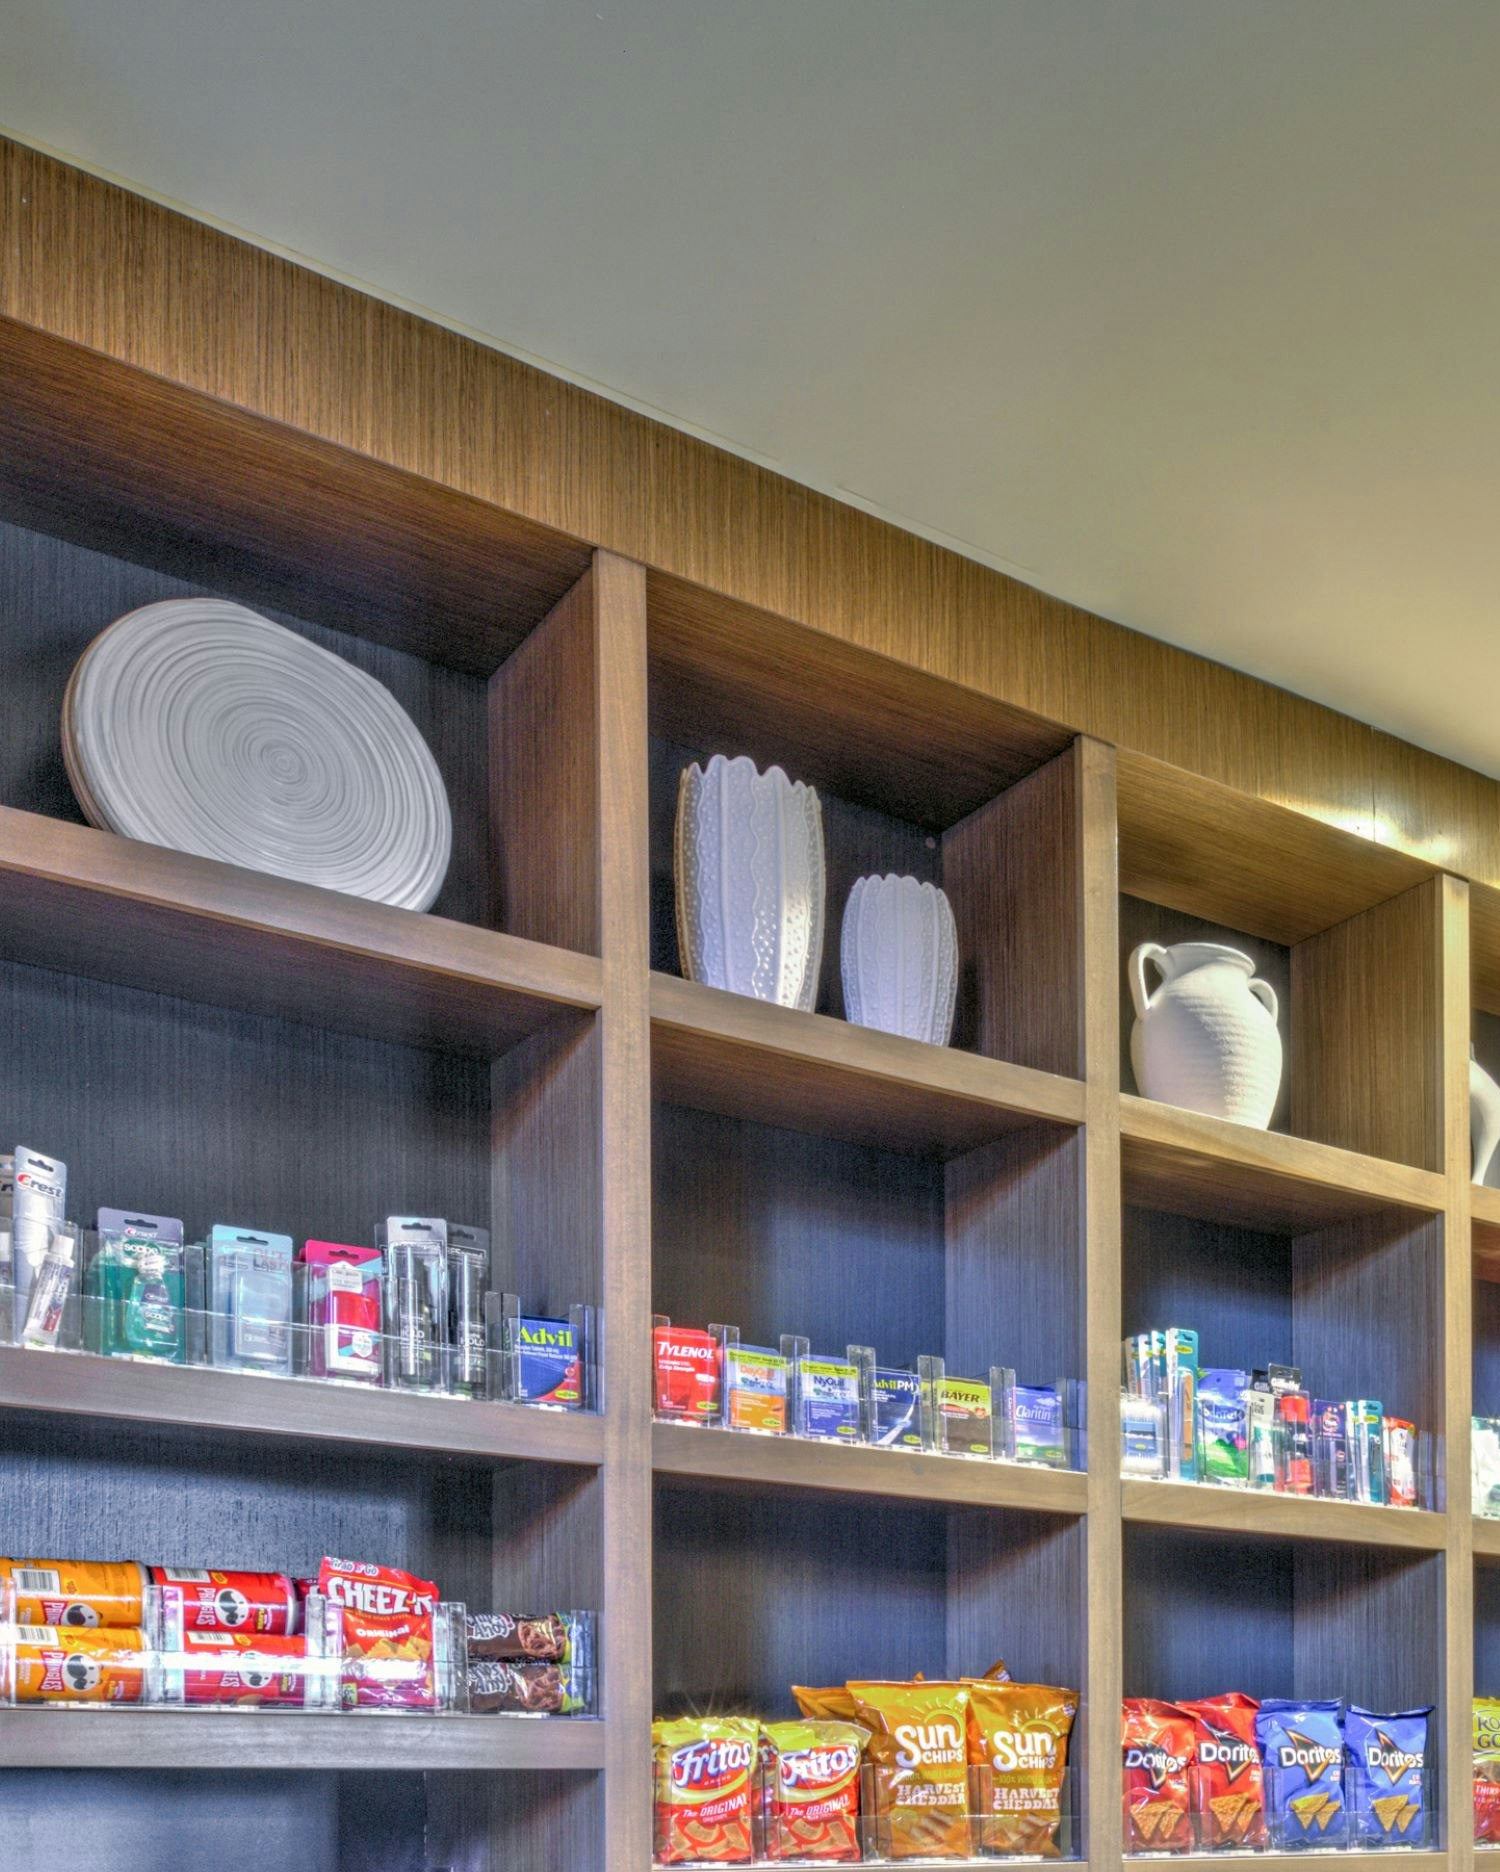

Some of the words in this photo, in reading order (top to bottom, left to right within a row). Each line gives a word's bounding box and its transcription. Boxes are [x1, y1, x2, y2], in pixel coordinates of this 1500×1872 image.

[17, 1173, 64, 1197] Crest
[124, 1243, 159, 1254] scope
[520, 1326, 573, 1347] Advil
[657, 1341, 714, 1360] TYLENOL
[941, 1390, 980, 1403] BAYER
[1016, 1405, 1051, 1420] Claritin
[365, 1564, 378, 1576] Go
[42, 1601, 67, 1625] PRING
[38, 1650, 67, 1692] PRINGLES
[895, 1723, 964, 1768] Sun
[993, 1730, 1057, 1771] Sun
[672, 1740, 750, 1788] Fritos
[780, 1745, 858, 1788] Fritos
[921, 1749, 963, 1764] CHIPS
[1018, 1755, 1055, 1769] CHIPS
[1125, 1749, 1188, 1772] Doritos
[1281, 1747, 1341, 1766] Doritos
[1368, 1747, 1424, 1768] Doritos
[993, 1799, 1059, 1811] CHEDDAR
